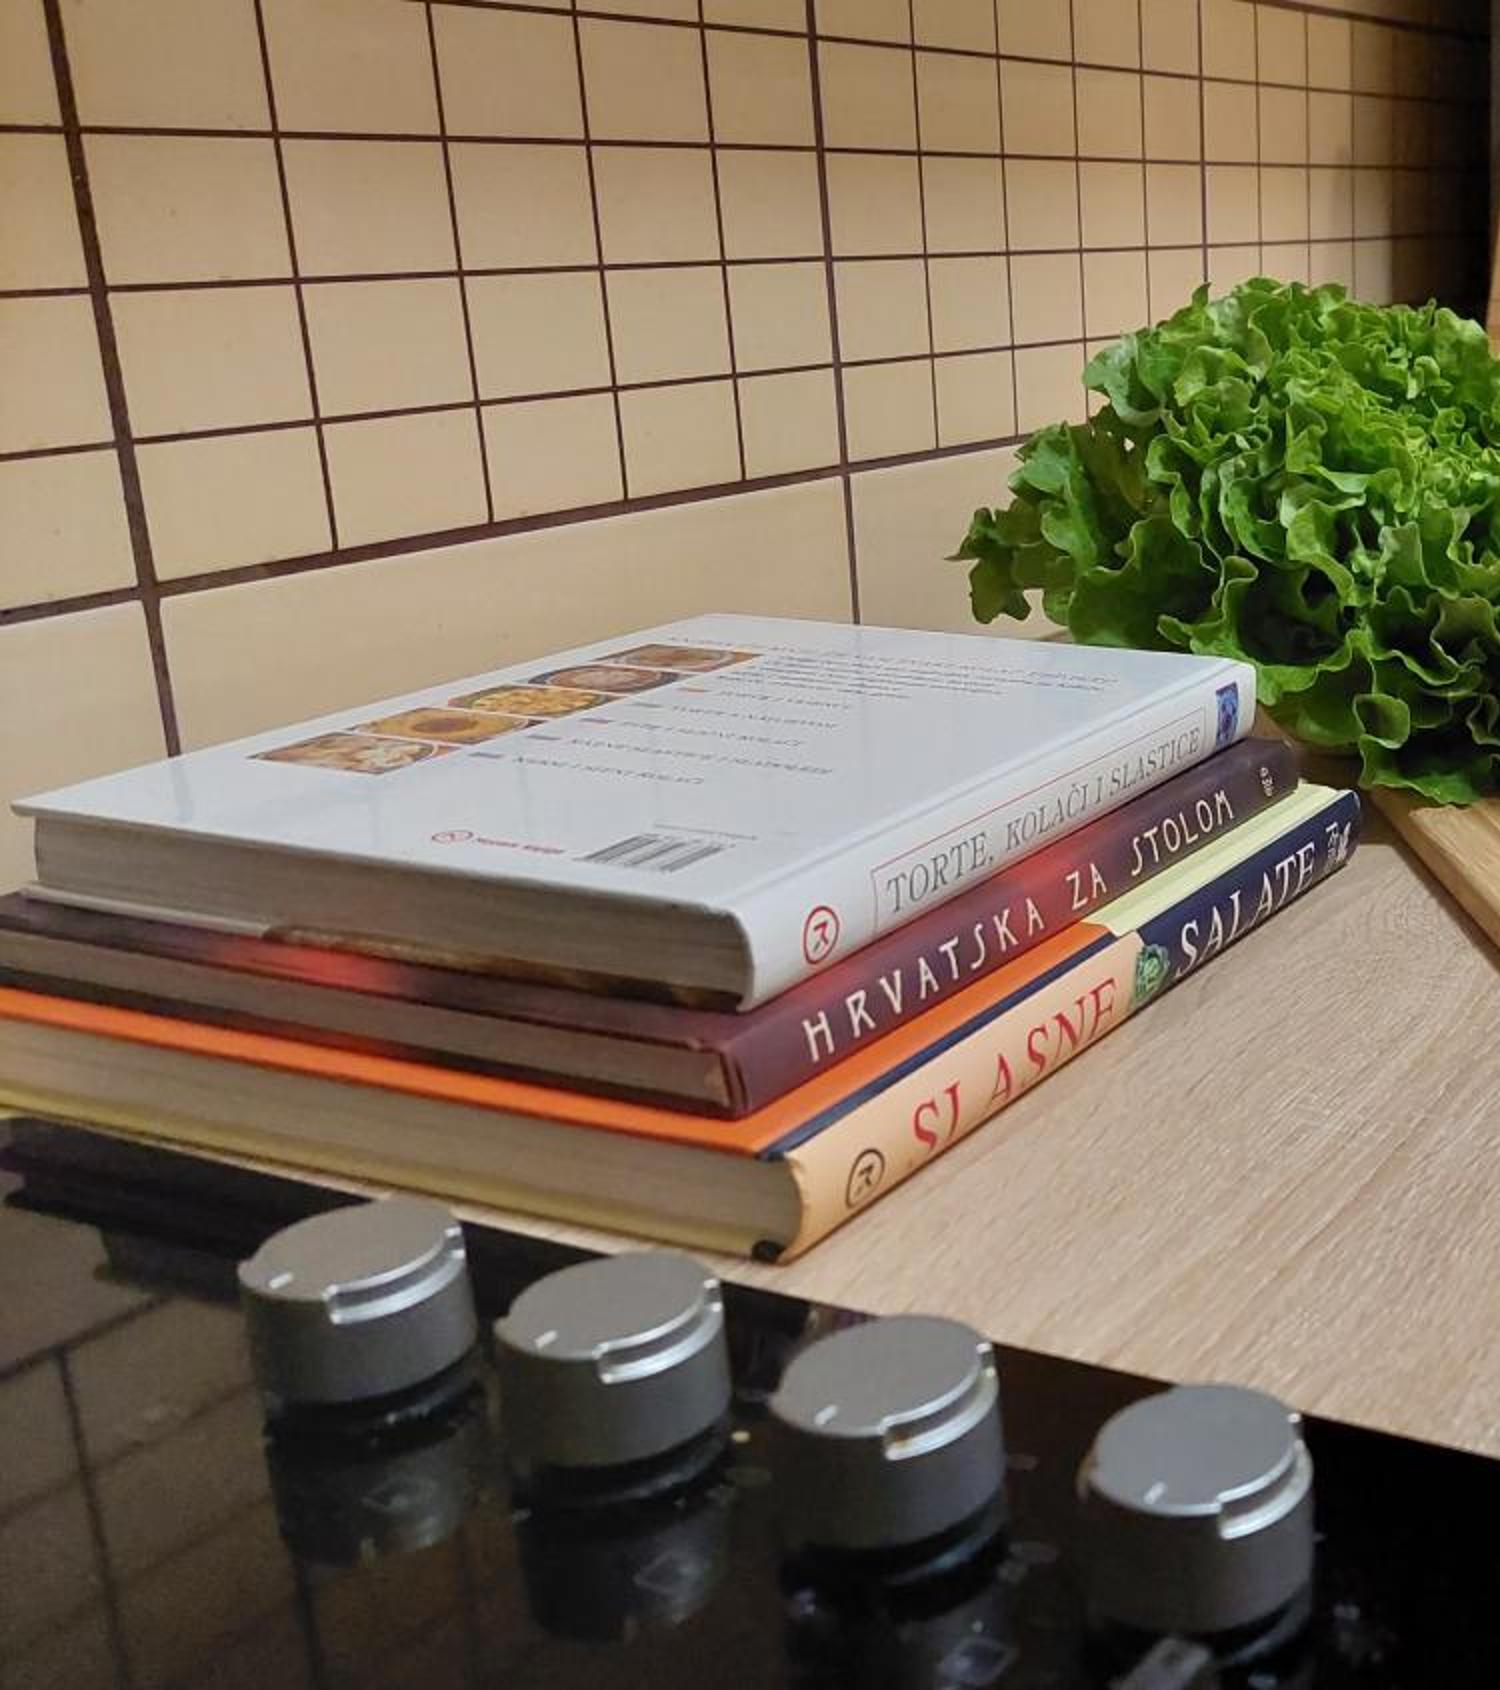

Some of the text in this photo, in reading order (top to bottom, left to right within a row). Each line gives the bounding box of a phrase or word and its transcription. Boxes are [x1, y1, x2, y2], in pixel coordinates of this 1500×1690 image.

[802, 789, 1234, 1062] HRVATSKA ZA STOLOM
[886, 727, 1201, 913] TORTE, KOLAČI I SLASTICE
[912, 841, 1316, 1153] SLASNE SALATE
